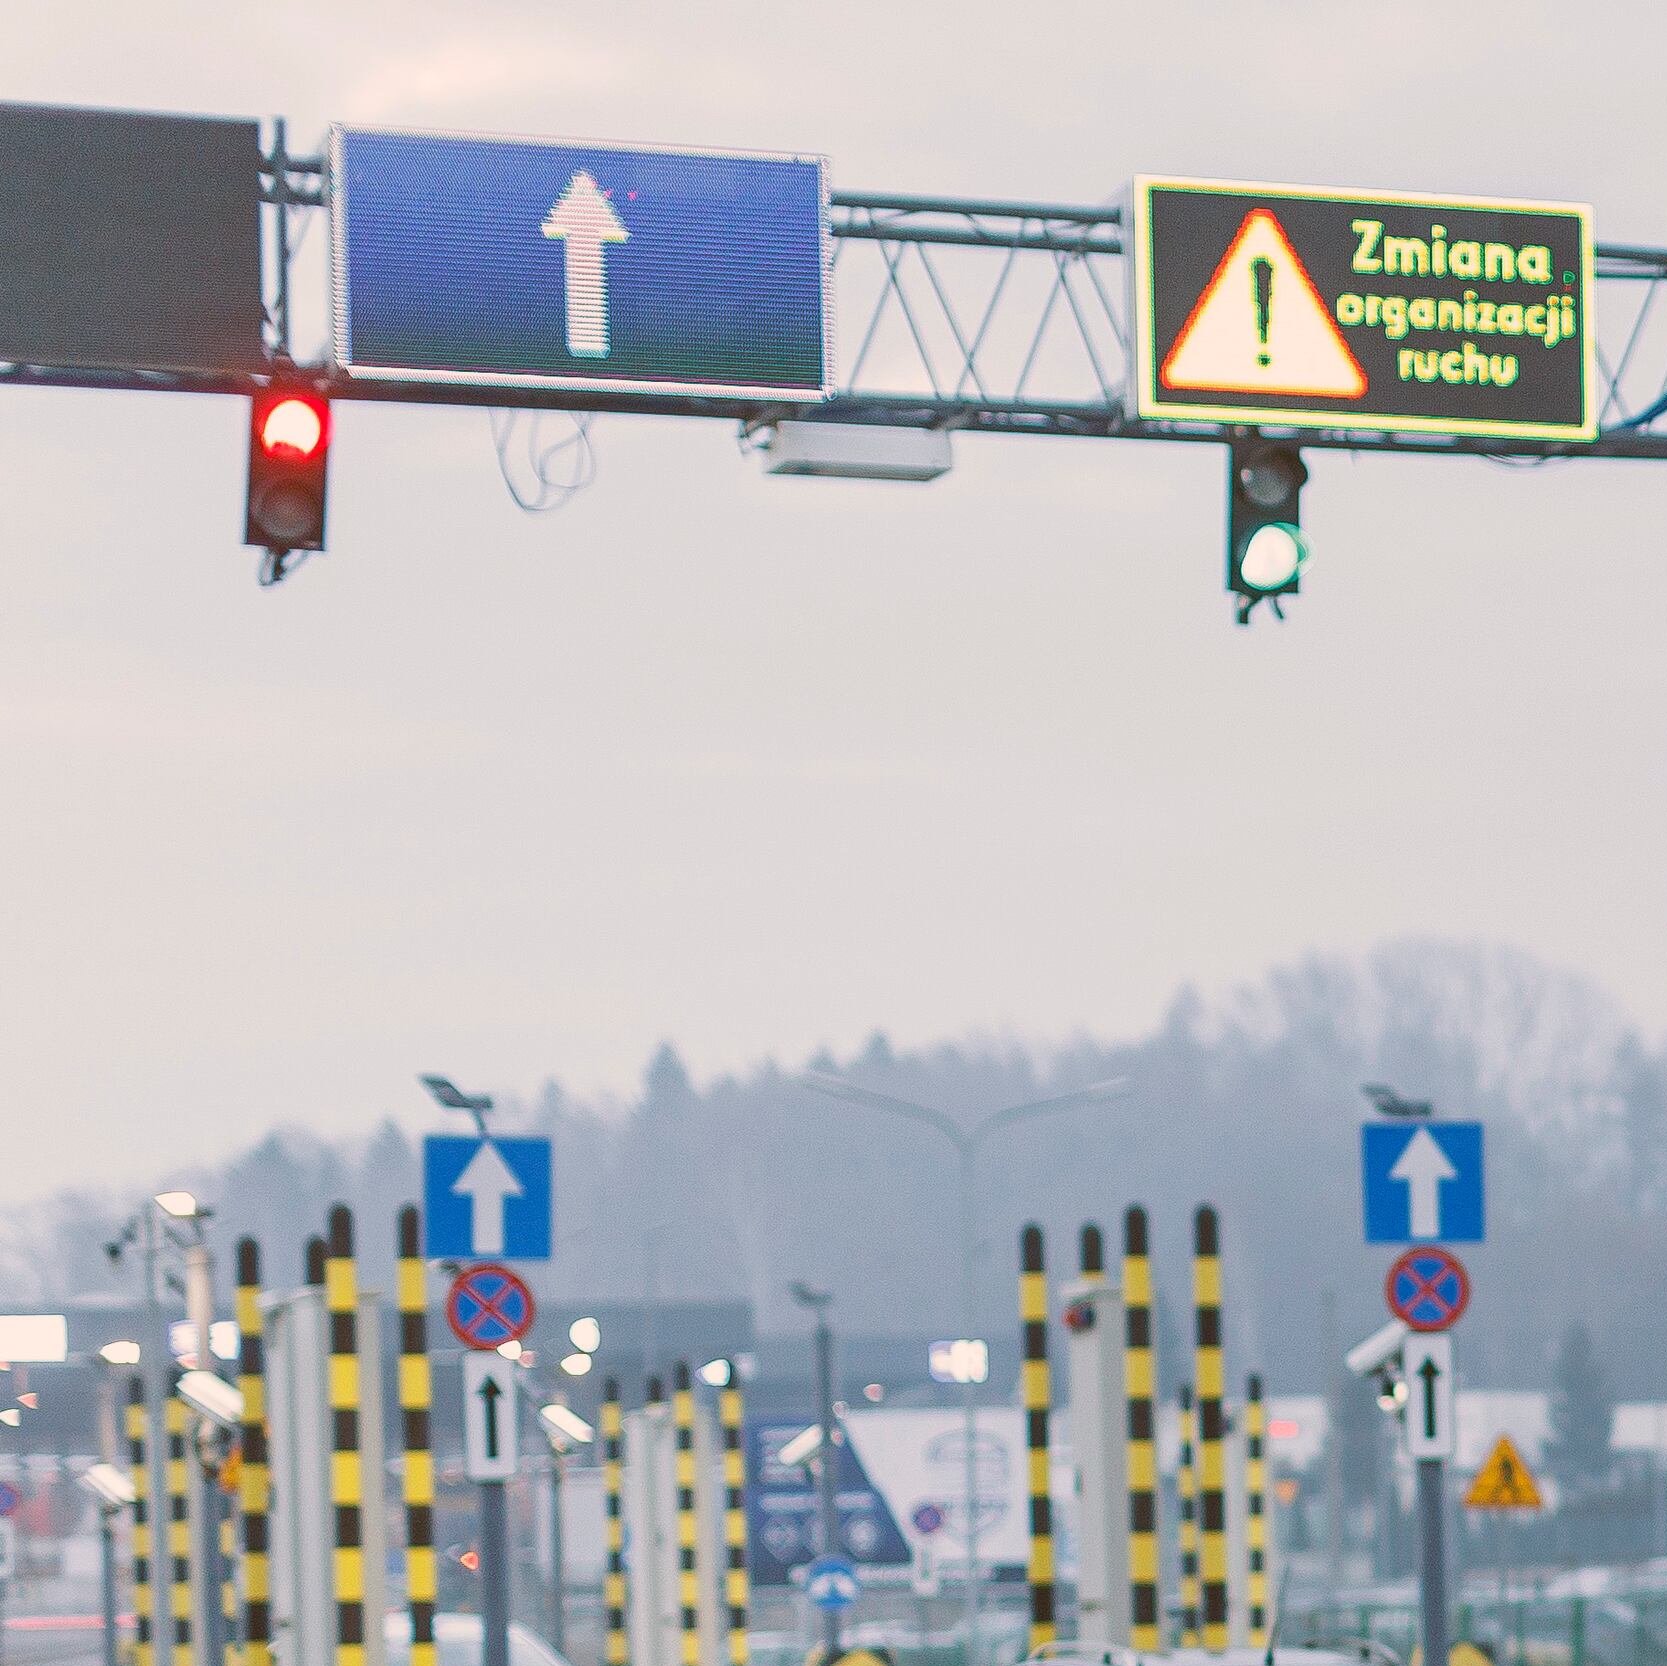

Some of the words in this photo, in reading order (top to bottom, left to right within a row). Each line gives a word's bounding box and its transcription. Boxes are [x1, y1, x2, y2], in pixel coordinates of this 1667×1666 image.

[1350, 218, 1554, 284] Zmiana
[1336, 289, 1577, 348] organizacji
[1398, 342, 1519, 386] ruchu
